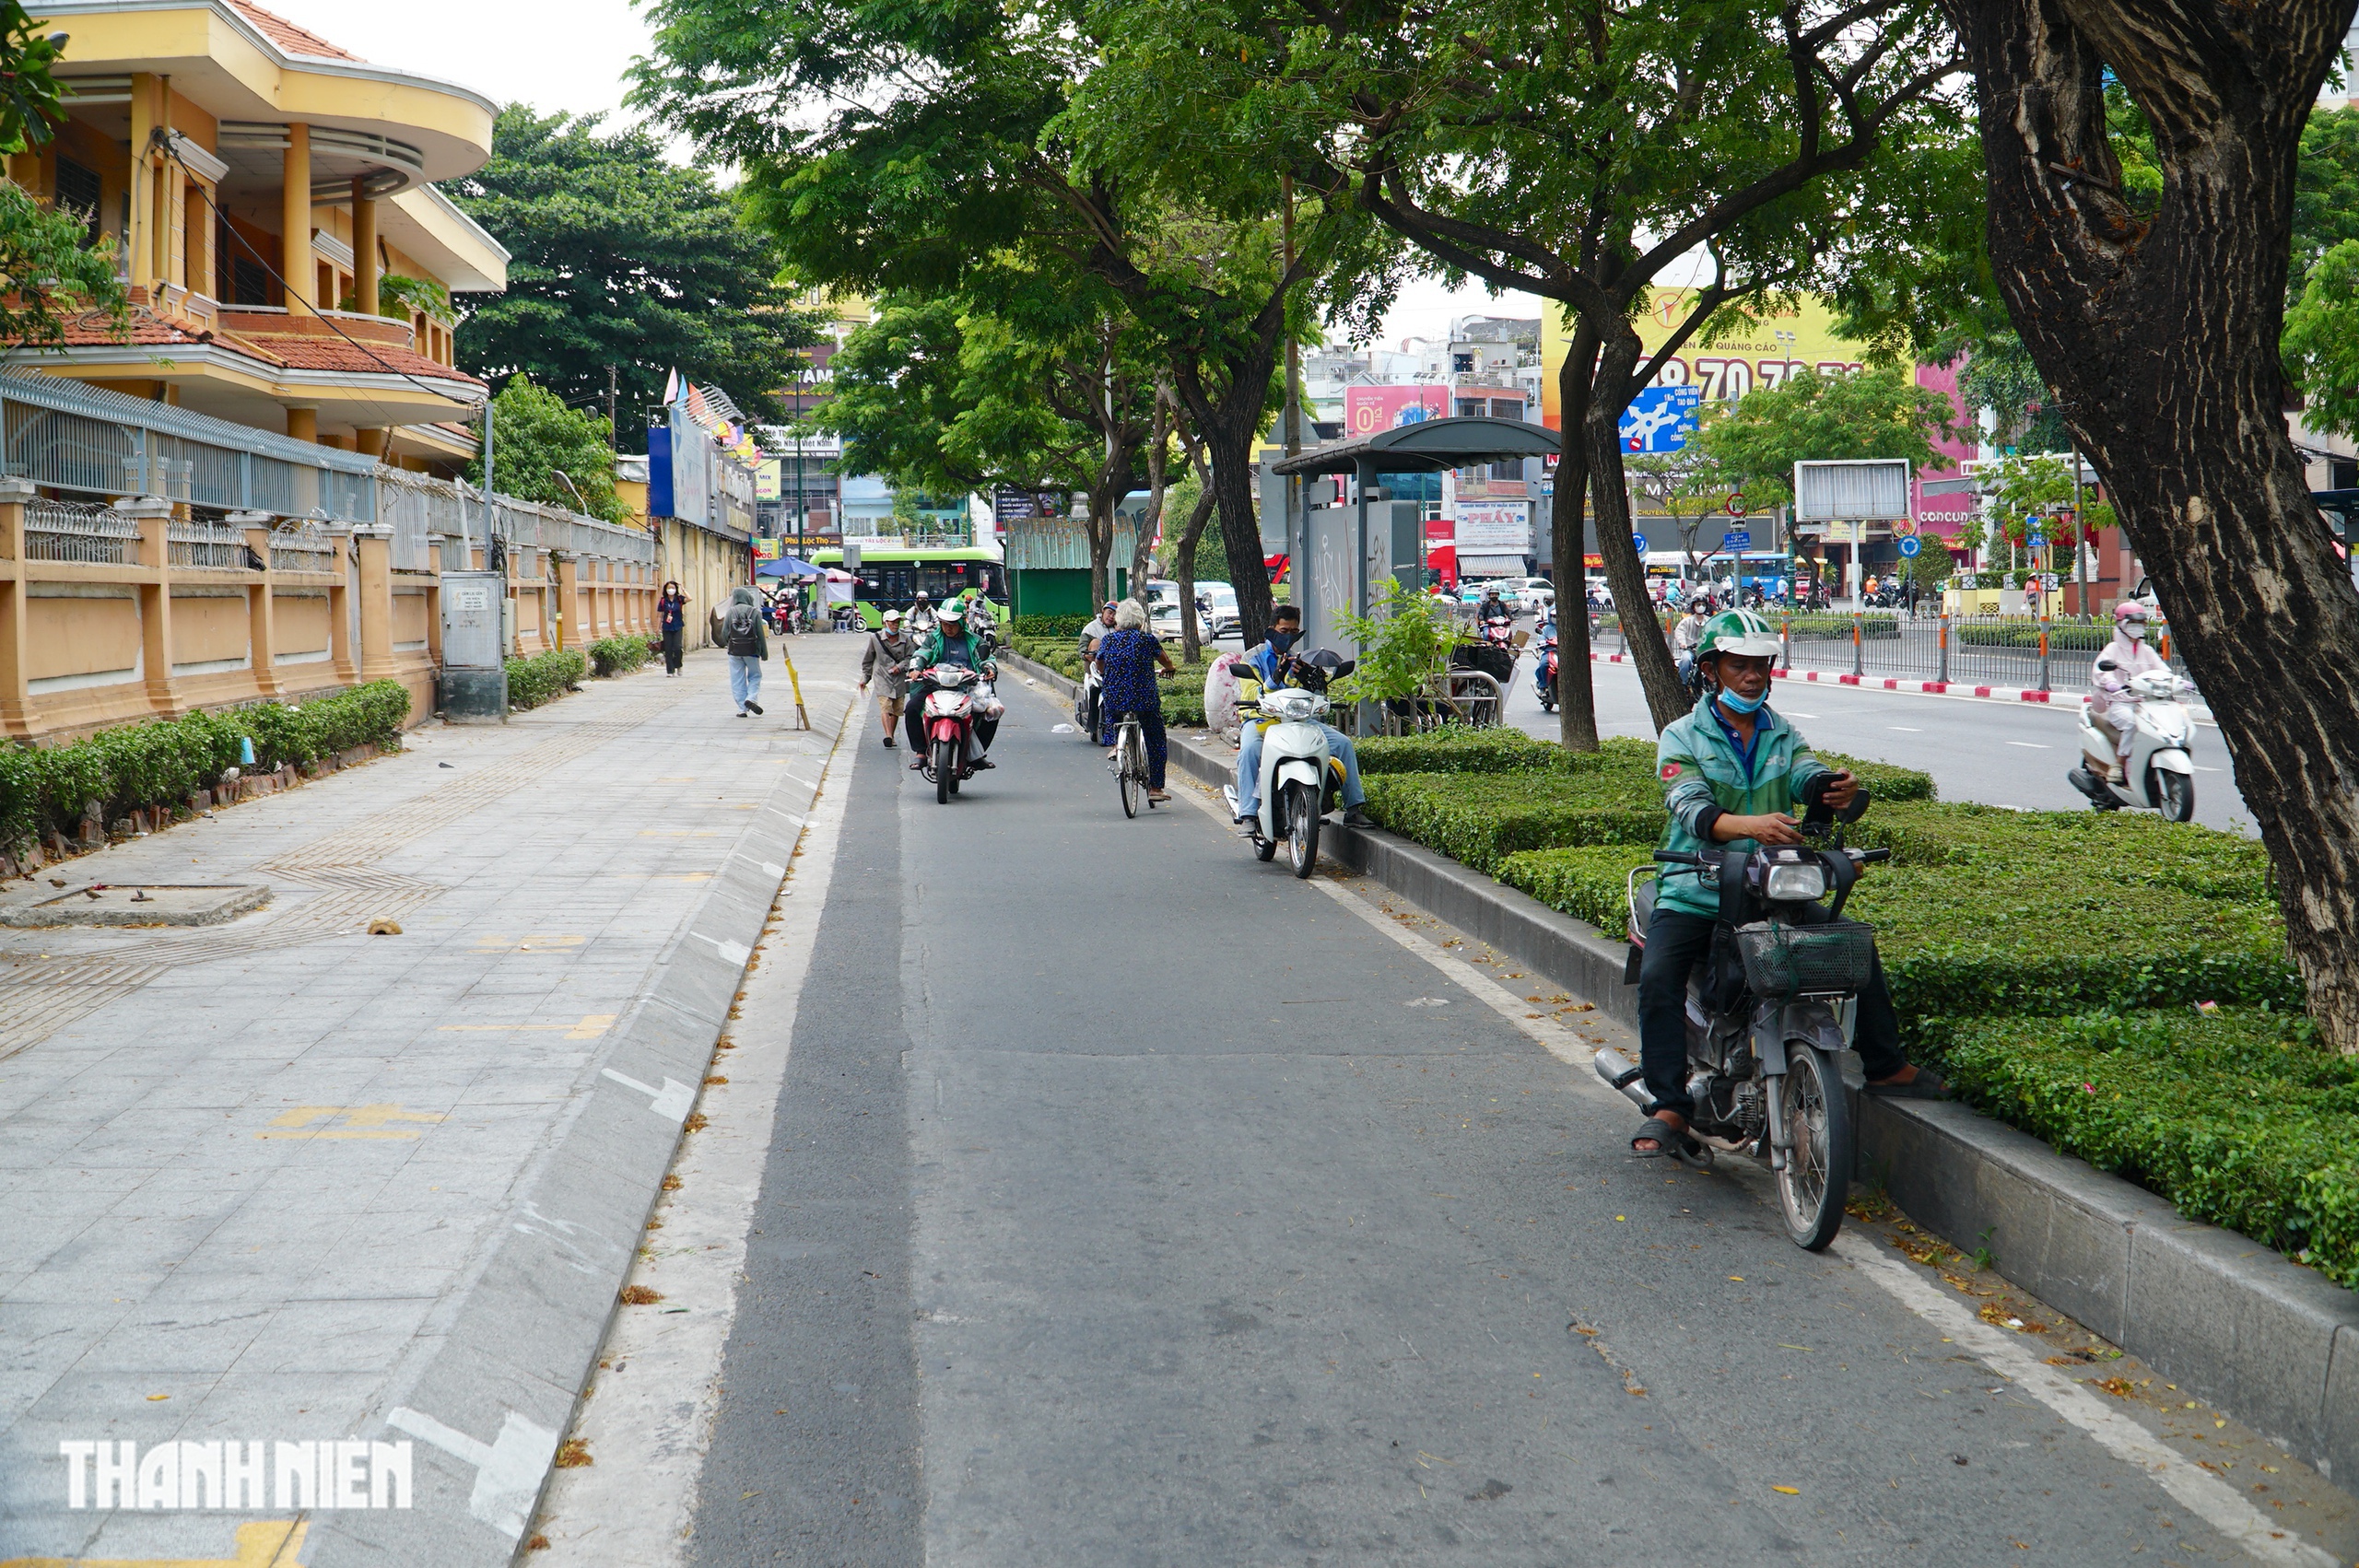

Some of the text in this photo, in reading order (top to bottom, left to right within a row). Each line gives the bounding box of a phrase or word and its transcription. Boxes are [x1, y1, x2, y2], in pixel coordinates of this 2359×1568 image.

[1716, 341, 1752, 351] QUẢNG
[1755, 342, 1778, 352] CÁO
[1467, 508, 1517, 523] PHẤY
[784, 536, 800, 544] Phú
[814, 536, 829, 545] Thọ
